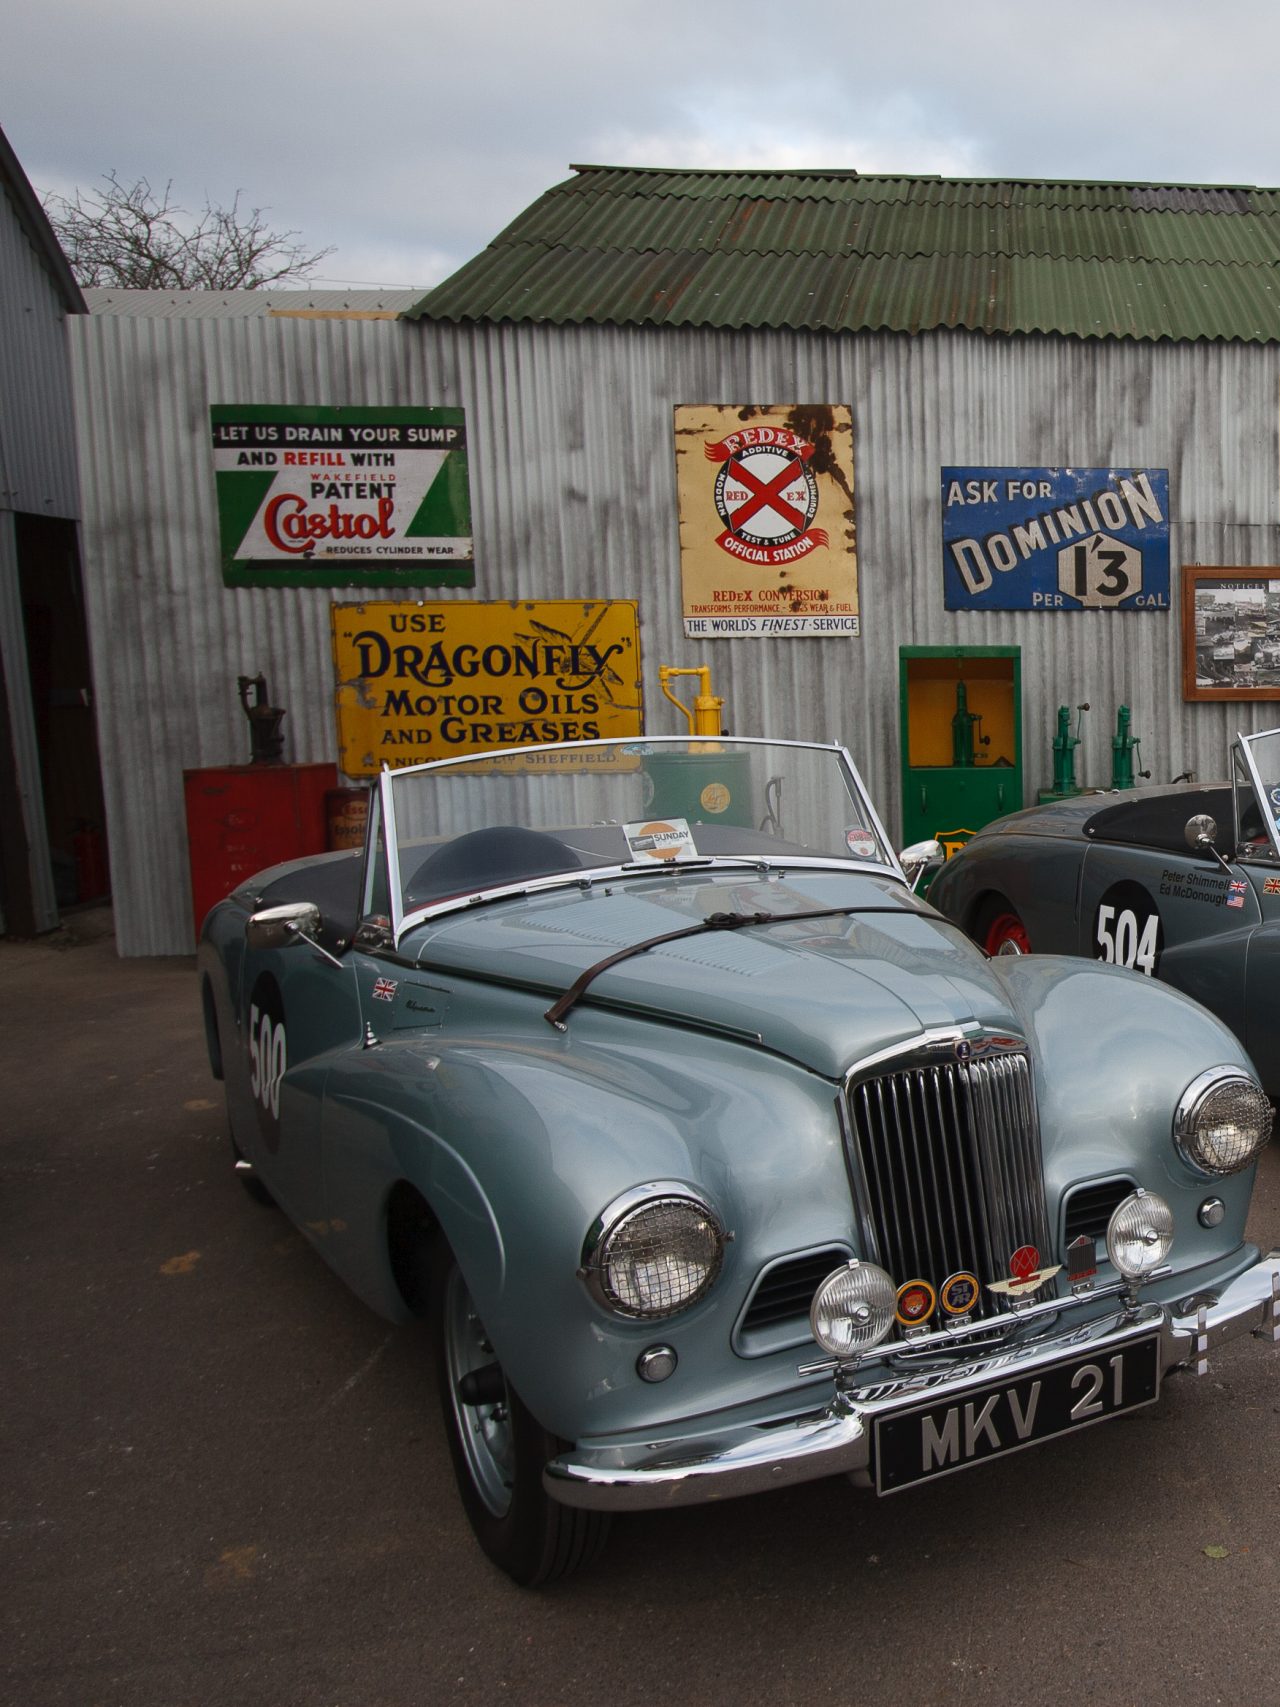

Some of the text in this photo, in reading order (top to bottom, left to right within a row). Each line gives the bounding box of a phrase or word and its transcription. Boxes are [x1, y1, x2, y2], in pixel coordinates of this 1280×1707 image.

[220, 426, 458, 442] LET US DRAIN YOUR SUMP
[237, 452, 395, 467] AND REFILL WITH
[742, 445, 788, 457] ADDITIVE
[310, 473, 396, 482] WAKEFIELD
[311, 483, 397, 500] PATENT
[715, 473, 726, 516] MODERN
[726, 491, 807, 501] RED EX
[806, 474, 817, 518] EQUIPMENT
[947, 481, 1052, 507] ASK FOR
[264, 493, 396, 554] Castrol
[741, 532, 761, 545] TEST
[774, 532, 796, 545] TUNE
[951, 472, 1164, 595] DOMINION
[326, 546, 454, 555] REDUCES CYLINDER WEAR
[724, 536, 814, 562] OFFICIAL STATION
[758, 589, 829, 601] CONVERSION
[1032, 591, 1064, 607] PER
[691, 604, 732, 613] TRANSFORMS
[734, 604, 780, 613] PERFORMANCE
[810, 603, 828, 612] WEAR
[836, 603, 853, 612] FUEL
[390, 614, 446, 633] USE
[687, 619, 708, 632] THE
[712, 618, 757, 631] WORLD'S
[761, 618, 809, 631] FINEST
[380, 687, 600, 717] MOTOR OILS
[381, 717, 601, 745] AND GREASES
[653, 830, 689, 842] SUNDAY
[1161, 869, 1231, 892] Peter Shimmell
[1159, 884, 1228, 905] Ed McDonough
[1097, 904, 1159, 977] 504
[250, 1003, 287, 1120] 500
[921, 1354, 1123, 1472] MKV 21
